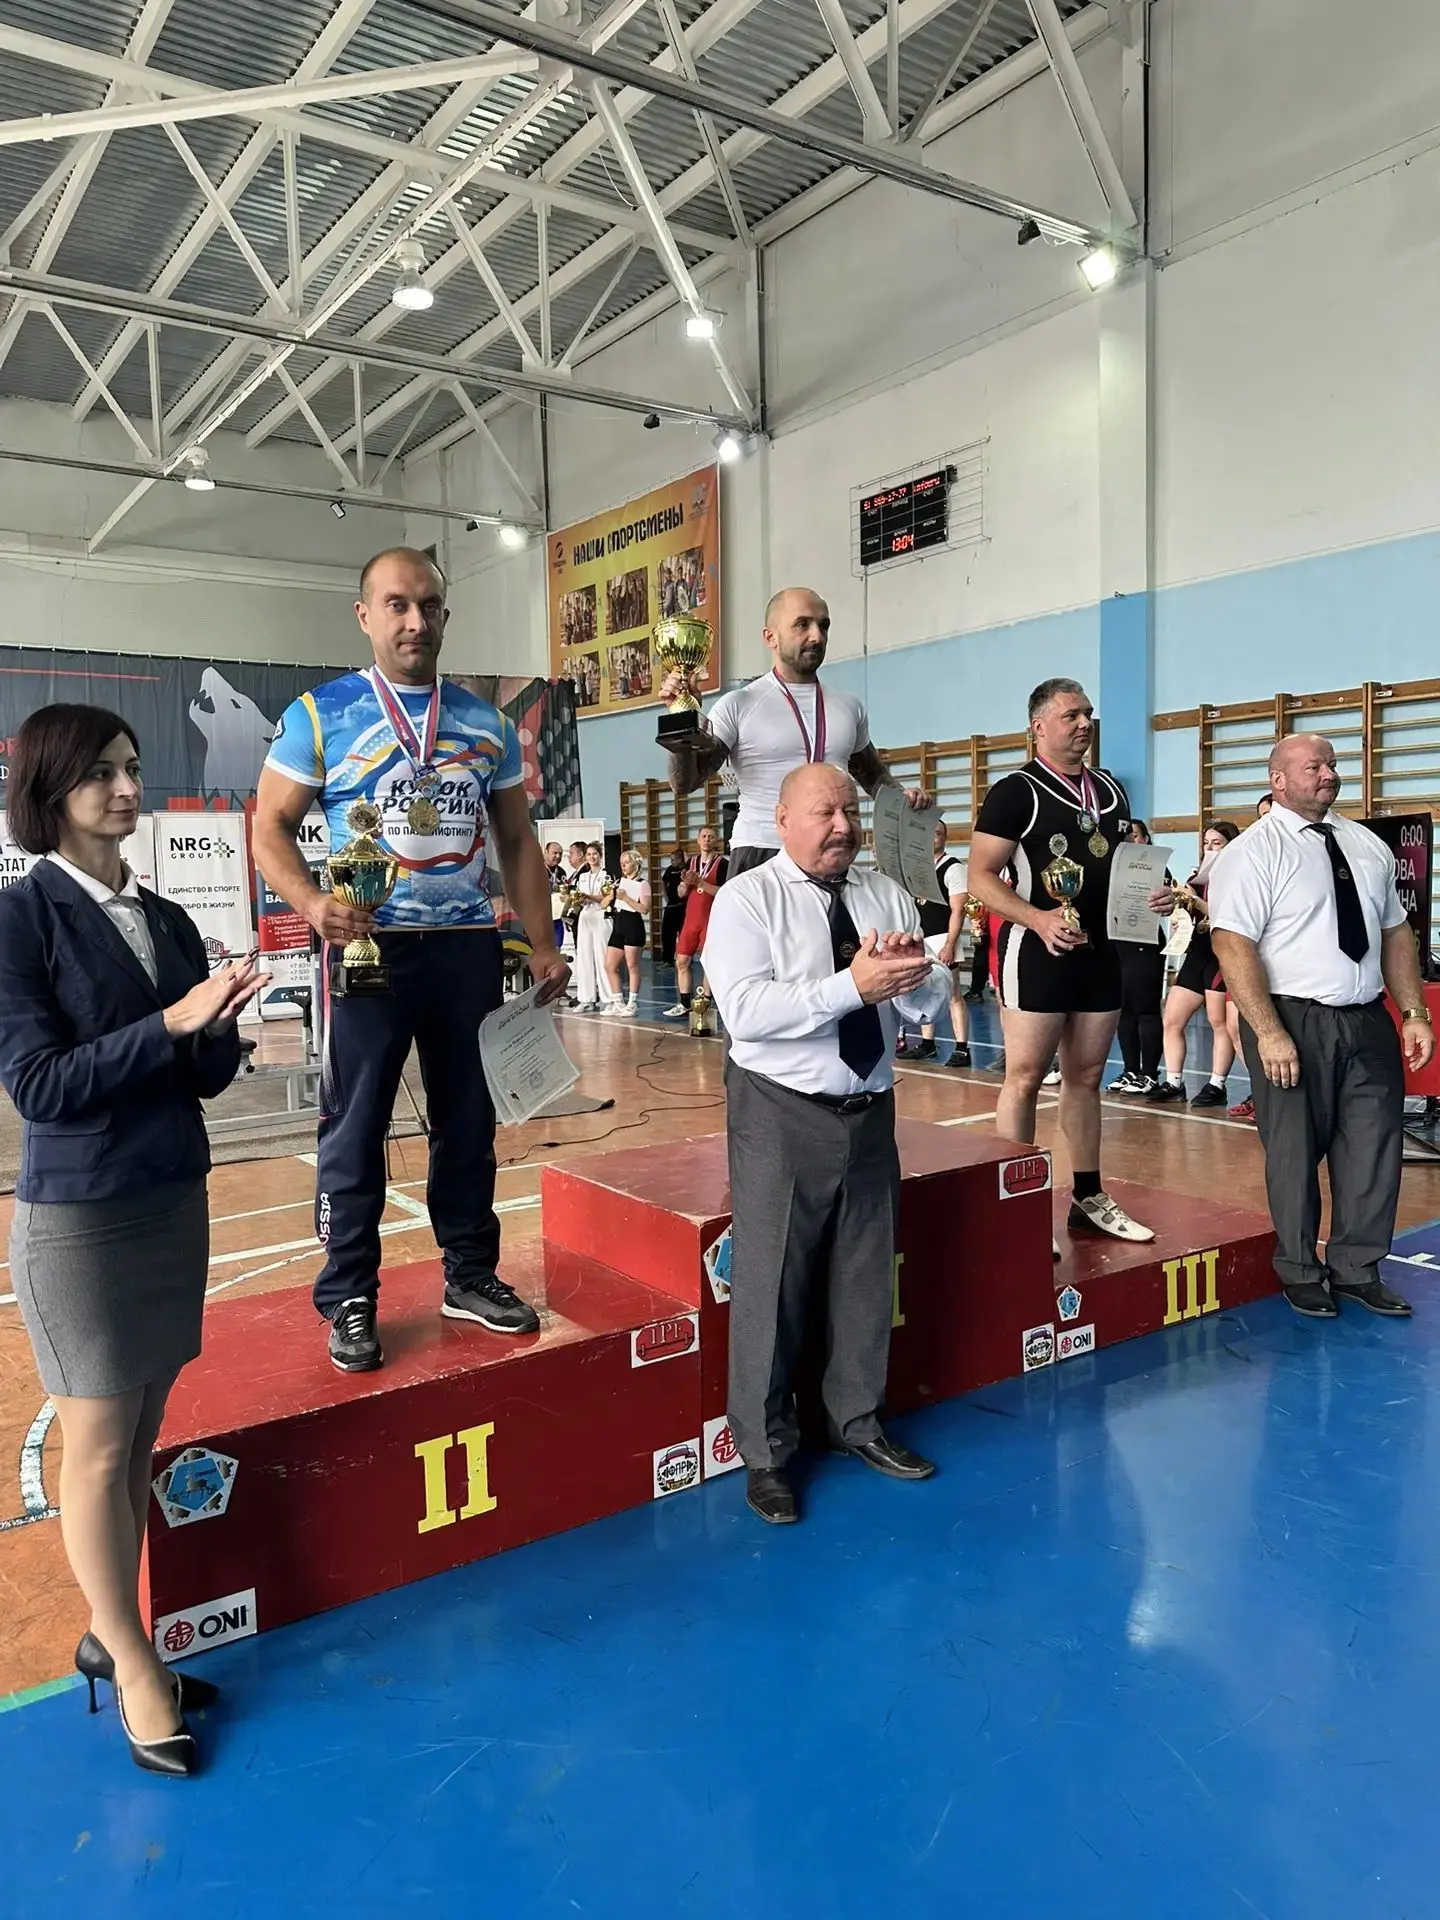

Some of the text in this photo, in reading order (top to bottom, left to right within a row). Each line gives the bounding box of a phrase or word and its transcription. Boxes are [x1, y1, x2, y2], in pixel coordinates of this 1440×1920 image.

[573, 502, 684, 567] НАШИ СПОРТСМЕНЫ
[390, 779, 474, 798] КУОК
[382, 798, 476, 816] РОСИИ
[388, 826, 474, 837] ПО ПАЛИФТИНГУ
[1400, 824, 1423, 847] 0:00
[170, 837, 211, 851] NRG
[168, 886, 207, 894] ЕДИНСТВО
[179, 902, 201, 910] ОБРО
[318, 1192, 331, 1249] USSIA
[1162, 1248, 1221, 1326] III
[651, 1322, 684, 1344] IPF
[1073, 1332, 1092, 1349] ONI
[414, 1421, 498, 1534] II
[198, 1604, 248, 1639] ONI
